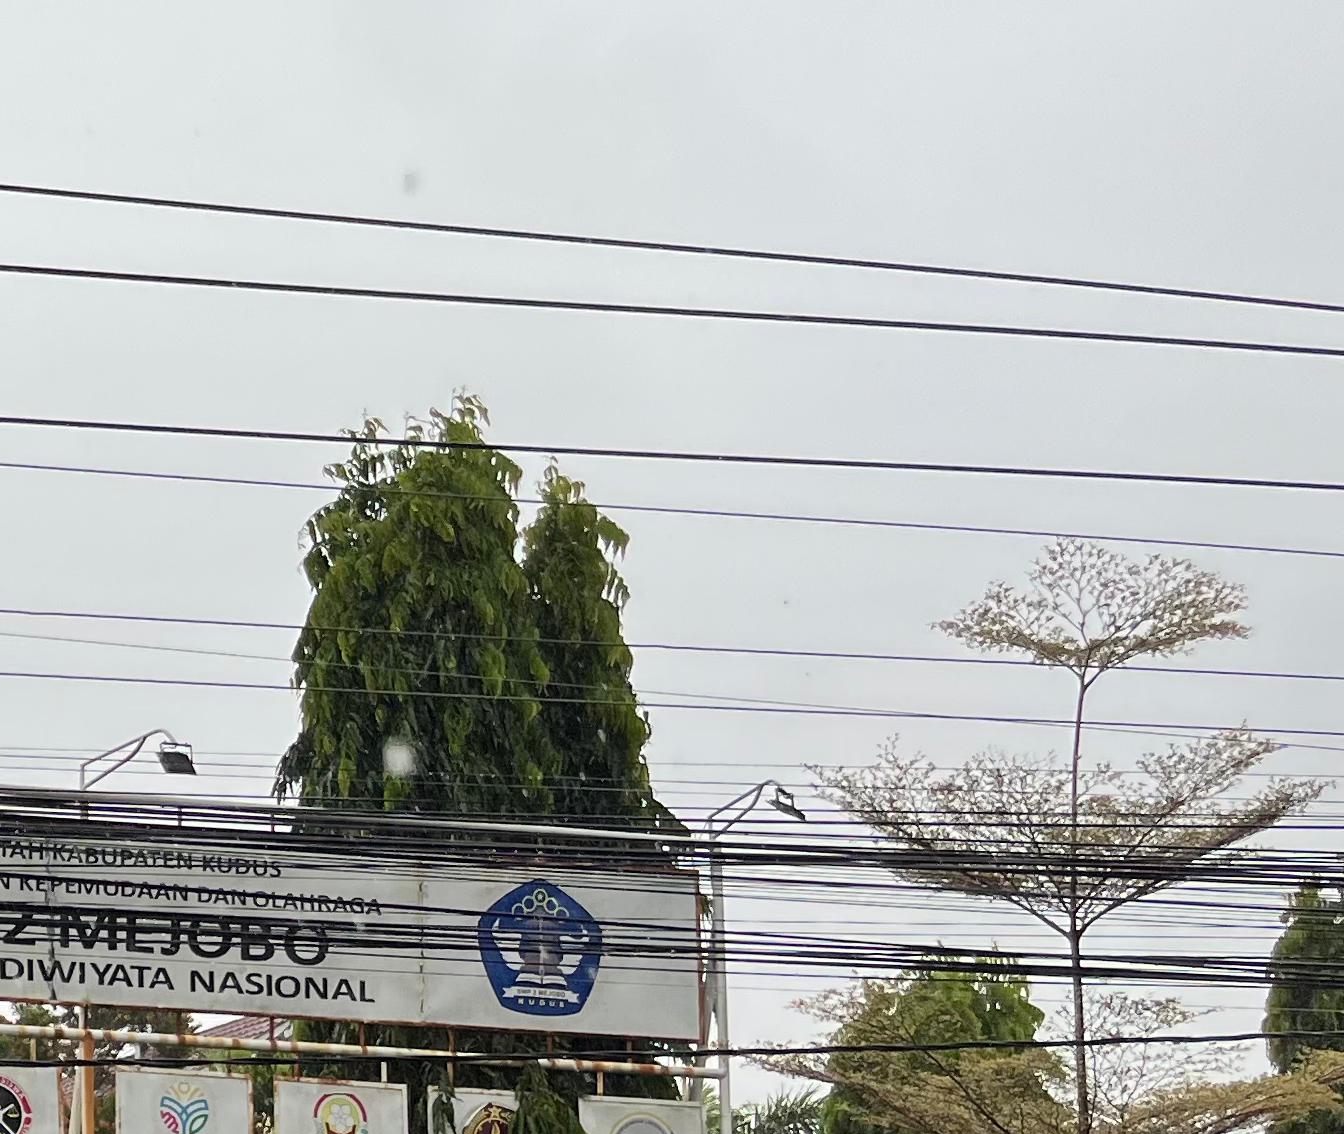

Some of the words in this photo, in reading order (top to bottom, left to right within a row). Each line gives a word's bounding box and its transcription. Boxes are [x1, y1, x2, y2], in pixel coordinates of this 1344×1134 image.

[53, 842, 193, 869] KABUPATEN
[202, 854, 281, 878] KUDUS
[20, 874, 189, 902] KEPEMUDAAN
[197, 886, 247, 906] DAN
[253, 889, 383, 916] OLAHRAGA
[2, 901, 37, 946] 2
[59, 908, 330, 966] MEJOBO
[189, 970, 376, 1003] NASIONAL
